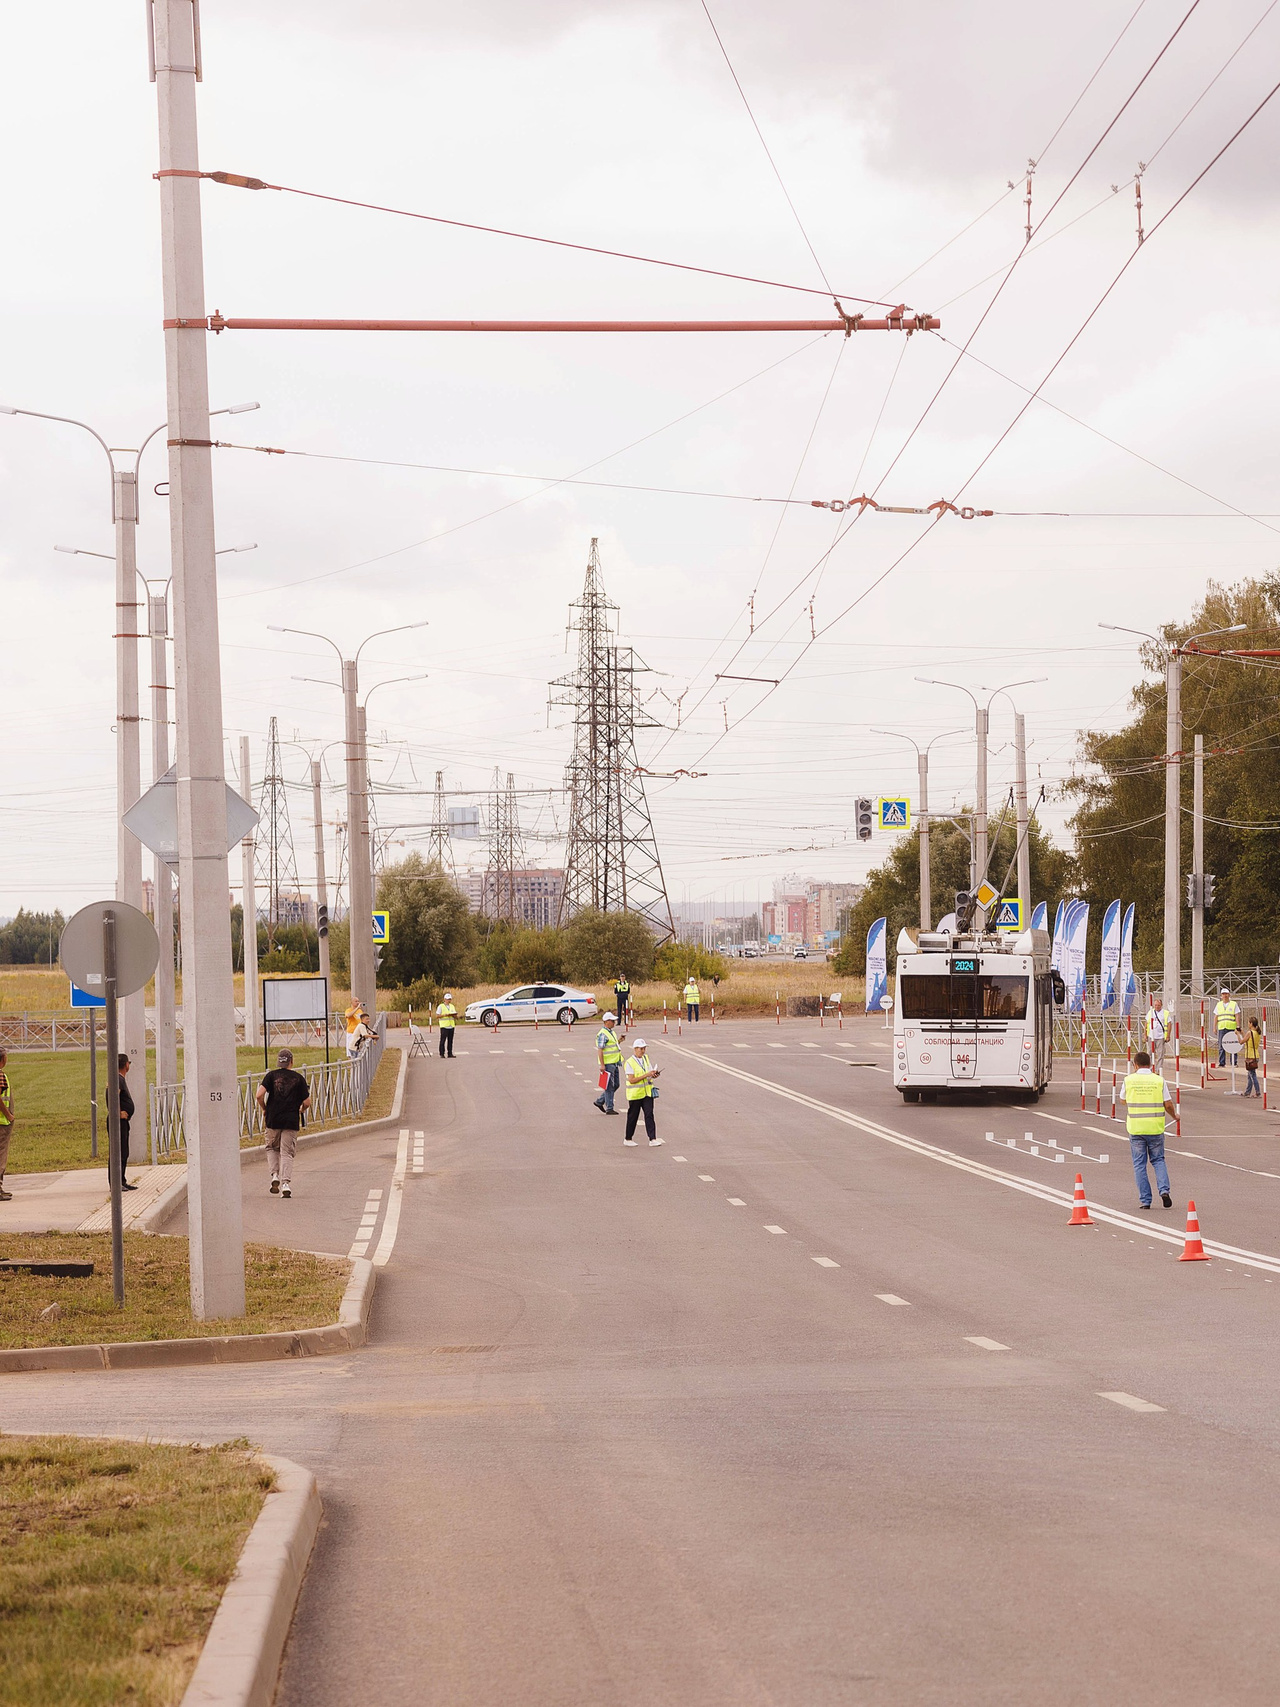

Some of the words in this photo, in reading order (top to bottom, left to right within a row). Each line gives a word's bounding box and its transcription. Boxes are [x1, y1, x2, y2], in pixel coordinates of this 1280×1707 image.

[955, 960, 974, 971] 2024
[924, 1037, 960, 1046] СОБЛЮДАЙ
[964, 1038, 1004, 1046] ДИСТАНЦИЮ
[956, 1054, 970, 1064] 946
[210, 1092, 222, 1102] 53
